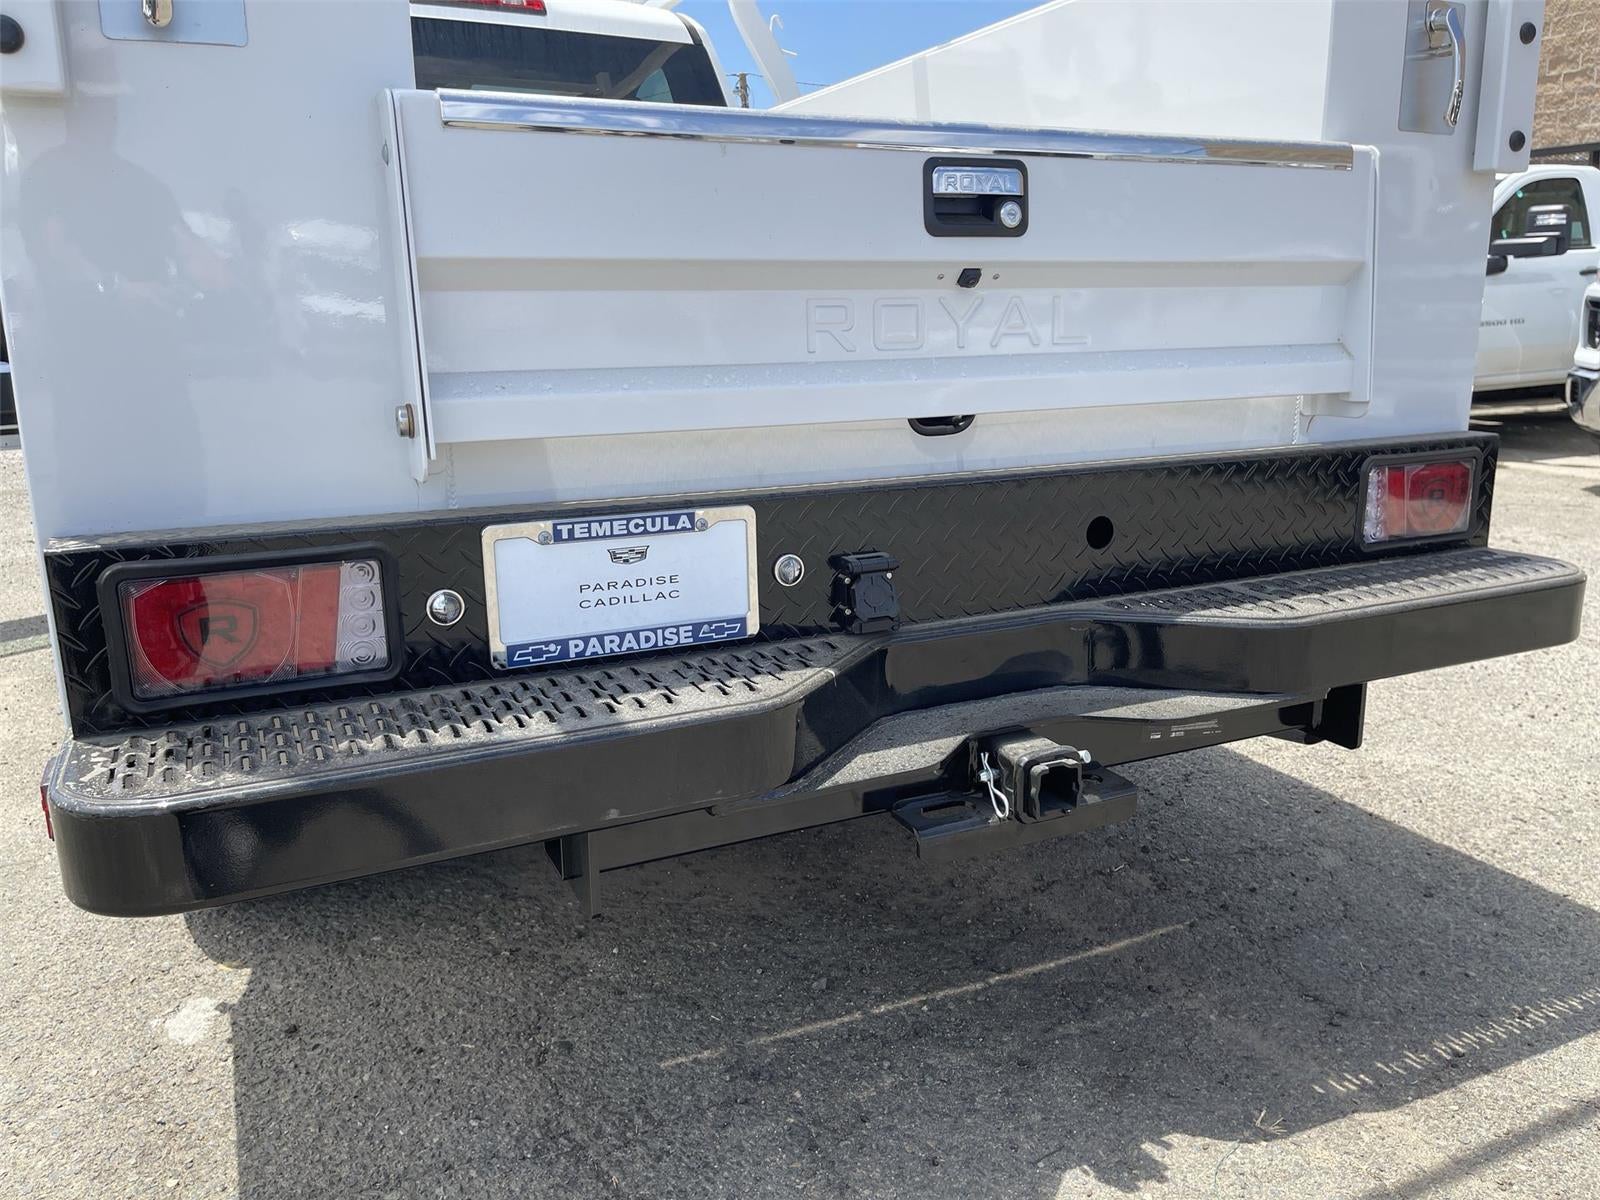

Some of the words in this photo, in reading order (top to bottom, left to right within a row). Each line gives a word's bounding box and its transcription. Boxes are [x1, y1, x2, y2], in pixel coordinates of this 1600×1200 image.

[943, 173, 1017, 192] ROYAL
[805, 296, 1092, 353] ROYAL
[557, 515, 691, 539] TEMECULA
[579, 574, 680, 594] PARADISE
[578, 589, 681, 609] CADILLAC
[568, 626, 693, 658] PARADISE
